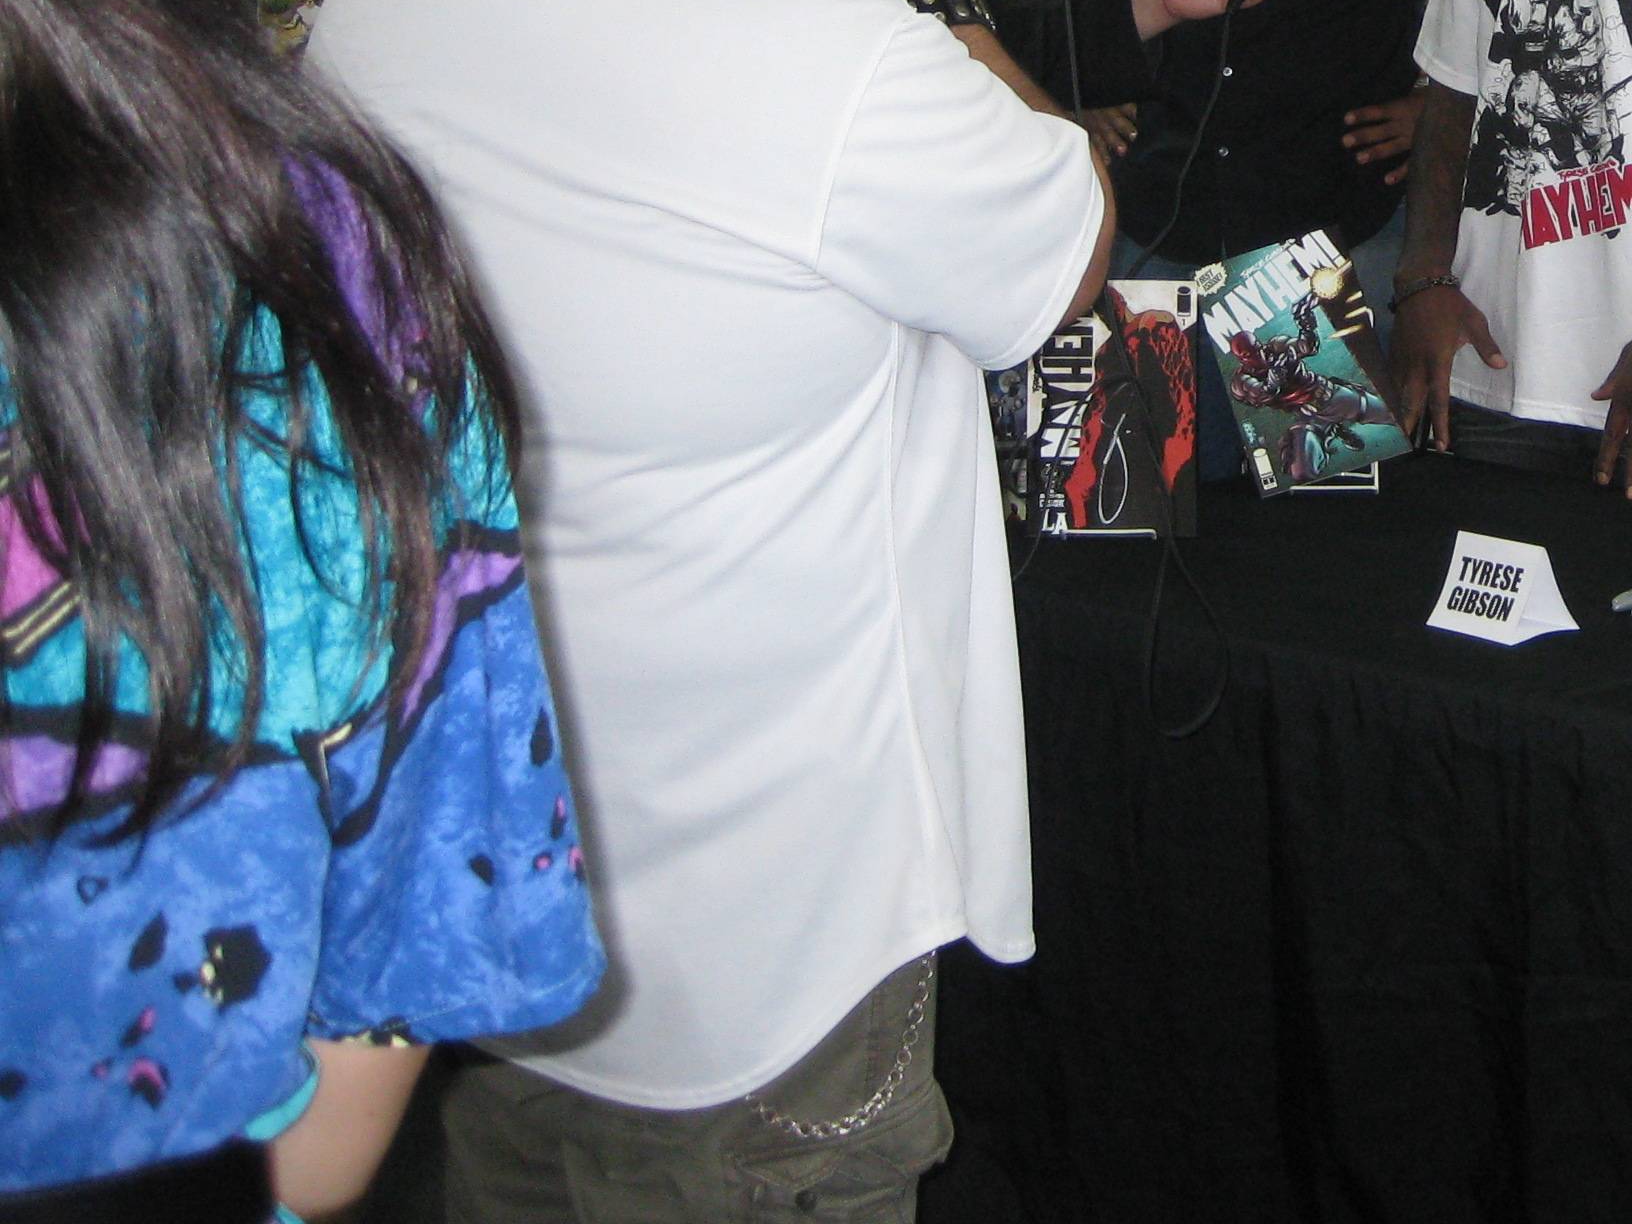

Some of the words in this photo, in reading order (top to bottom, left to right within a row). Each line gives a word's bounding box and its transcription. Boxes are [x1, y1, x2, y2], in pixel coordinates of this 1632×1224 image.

[1203, 229, 1346, 354] MAYHEM!
[1041, 509, 1068, 535] LA
[1458, 556, 1525, 595] TYRESE
[1445, 584, 1515, 623] GIBSON
